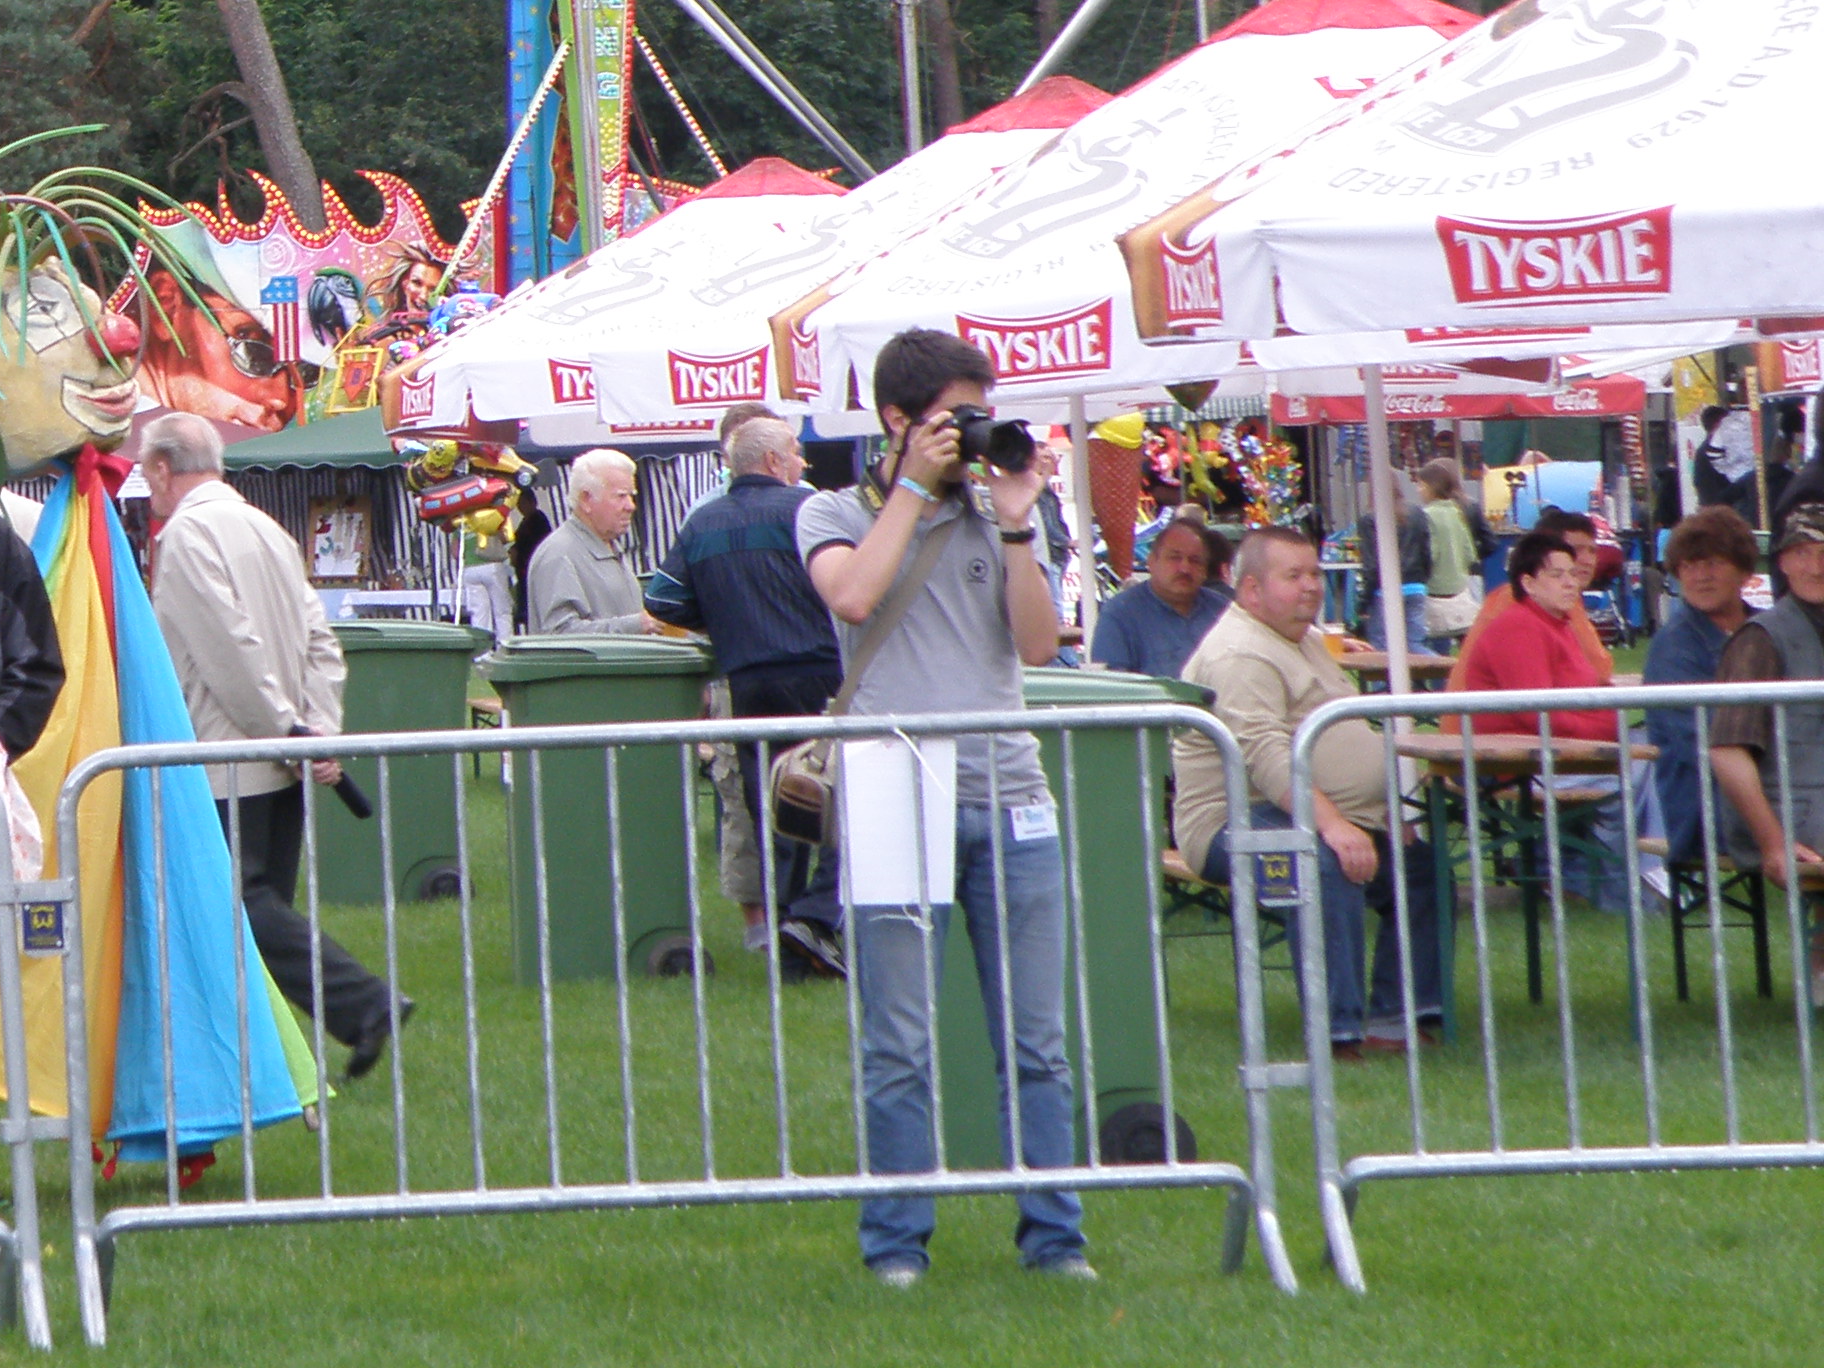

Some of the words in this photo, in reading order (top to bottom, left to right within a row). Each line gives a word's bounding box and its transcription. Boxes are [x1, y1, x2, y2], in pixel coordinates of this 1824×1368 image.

[1162, 250, 1220, 313] TYSKIE
[1453, 217, 1663, 294] TYSKIE
[968, 313, 1106, 374] TYSKIE
[401, 381, 433, 415] TYSKIE
[673, 355, 762, 400] TYSKIE
